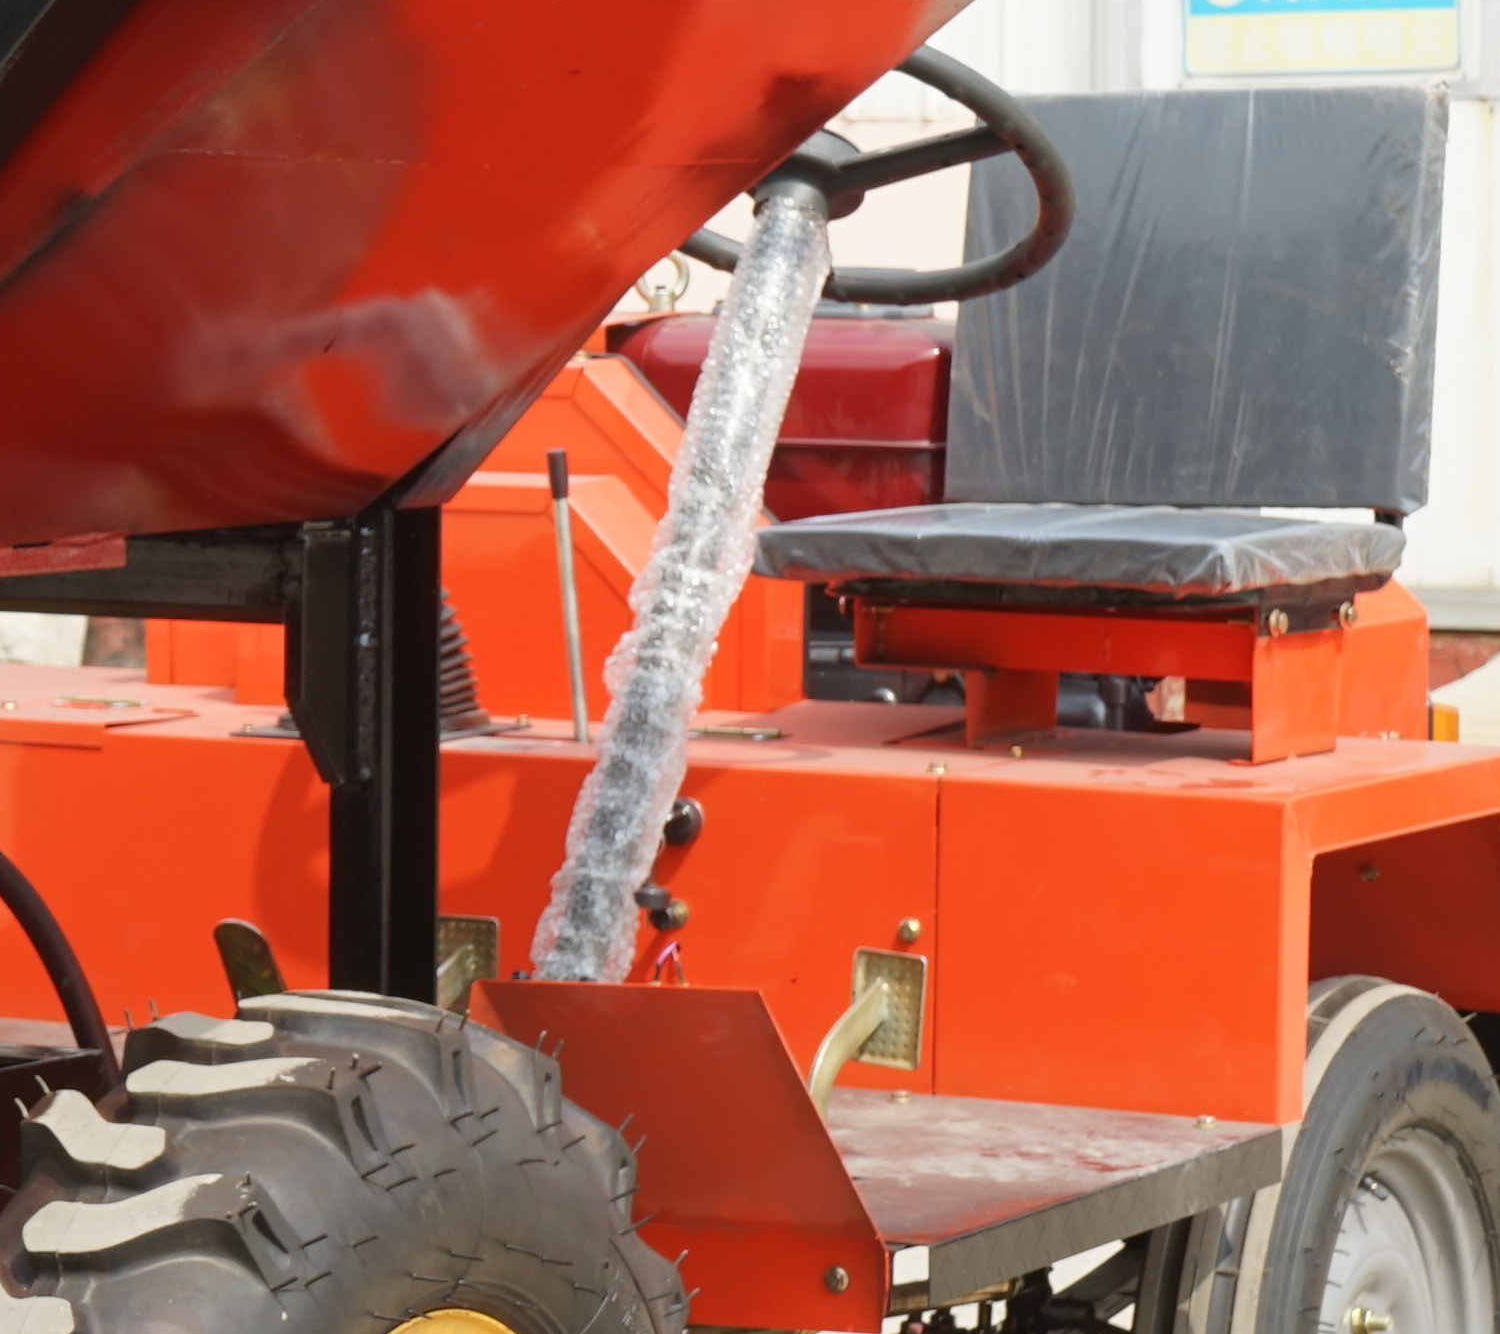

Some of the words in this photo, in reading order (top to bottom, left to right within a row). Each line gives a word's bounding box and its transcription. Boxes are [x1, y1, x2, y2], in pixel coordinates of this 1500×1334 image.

[1198, 16, 1446, 65] 禁止吸烟明火
